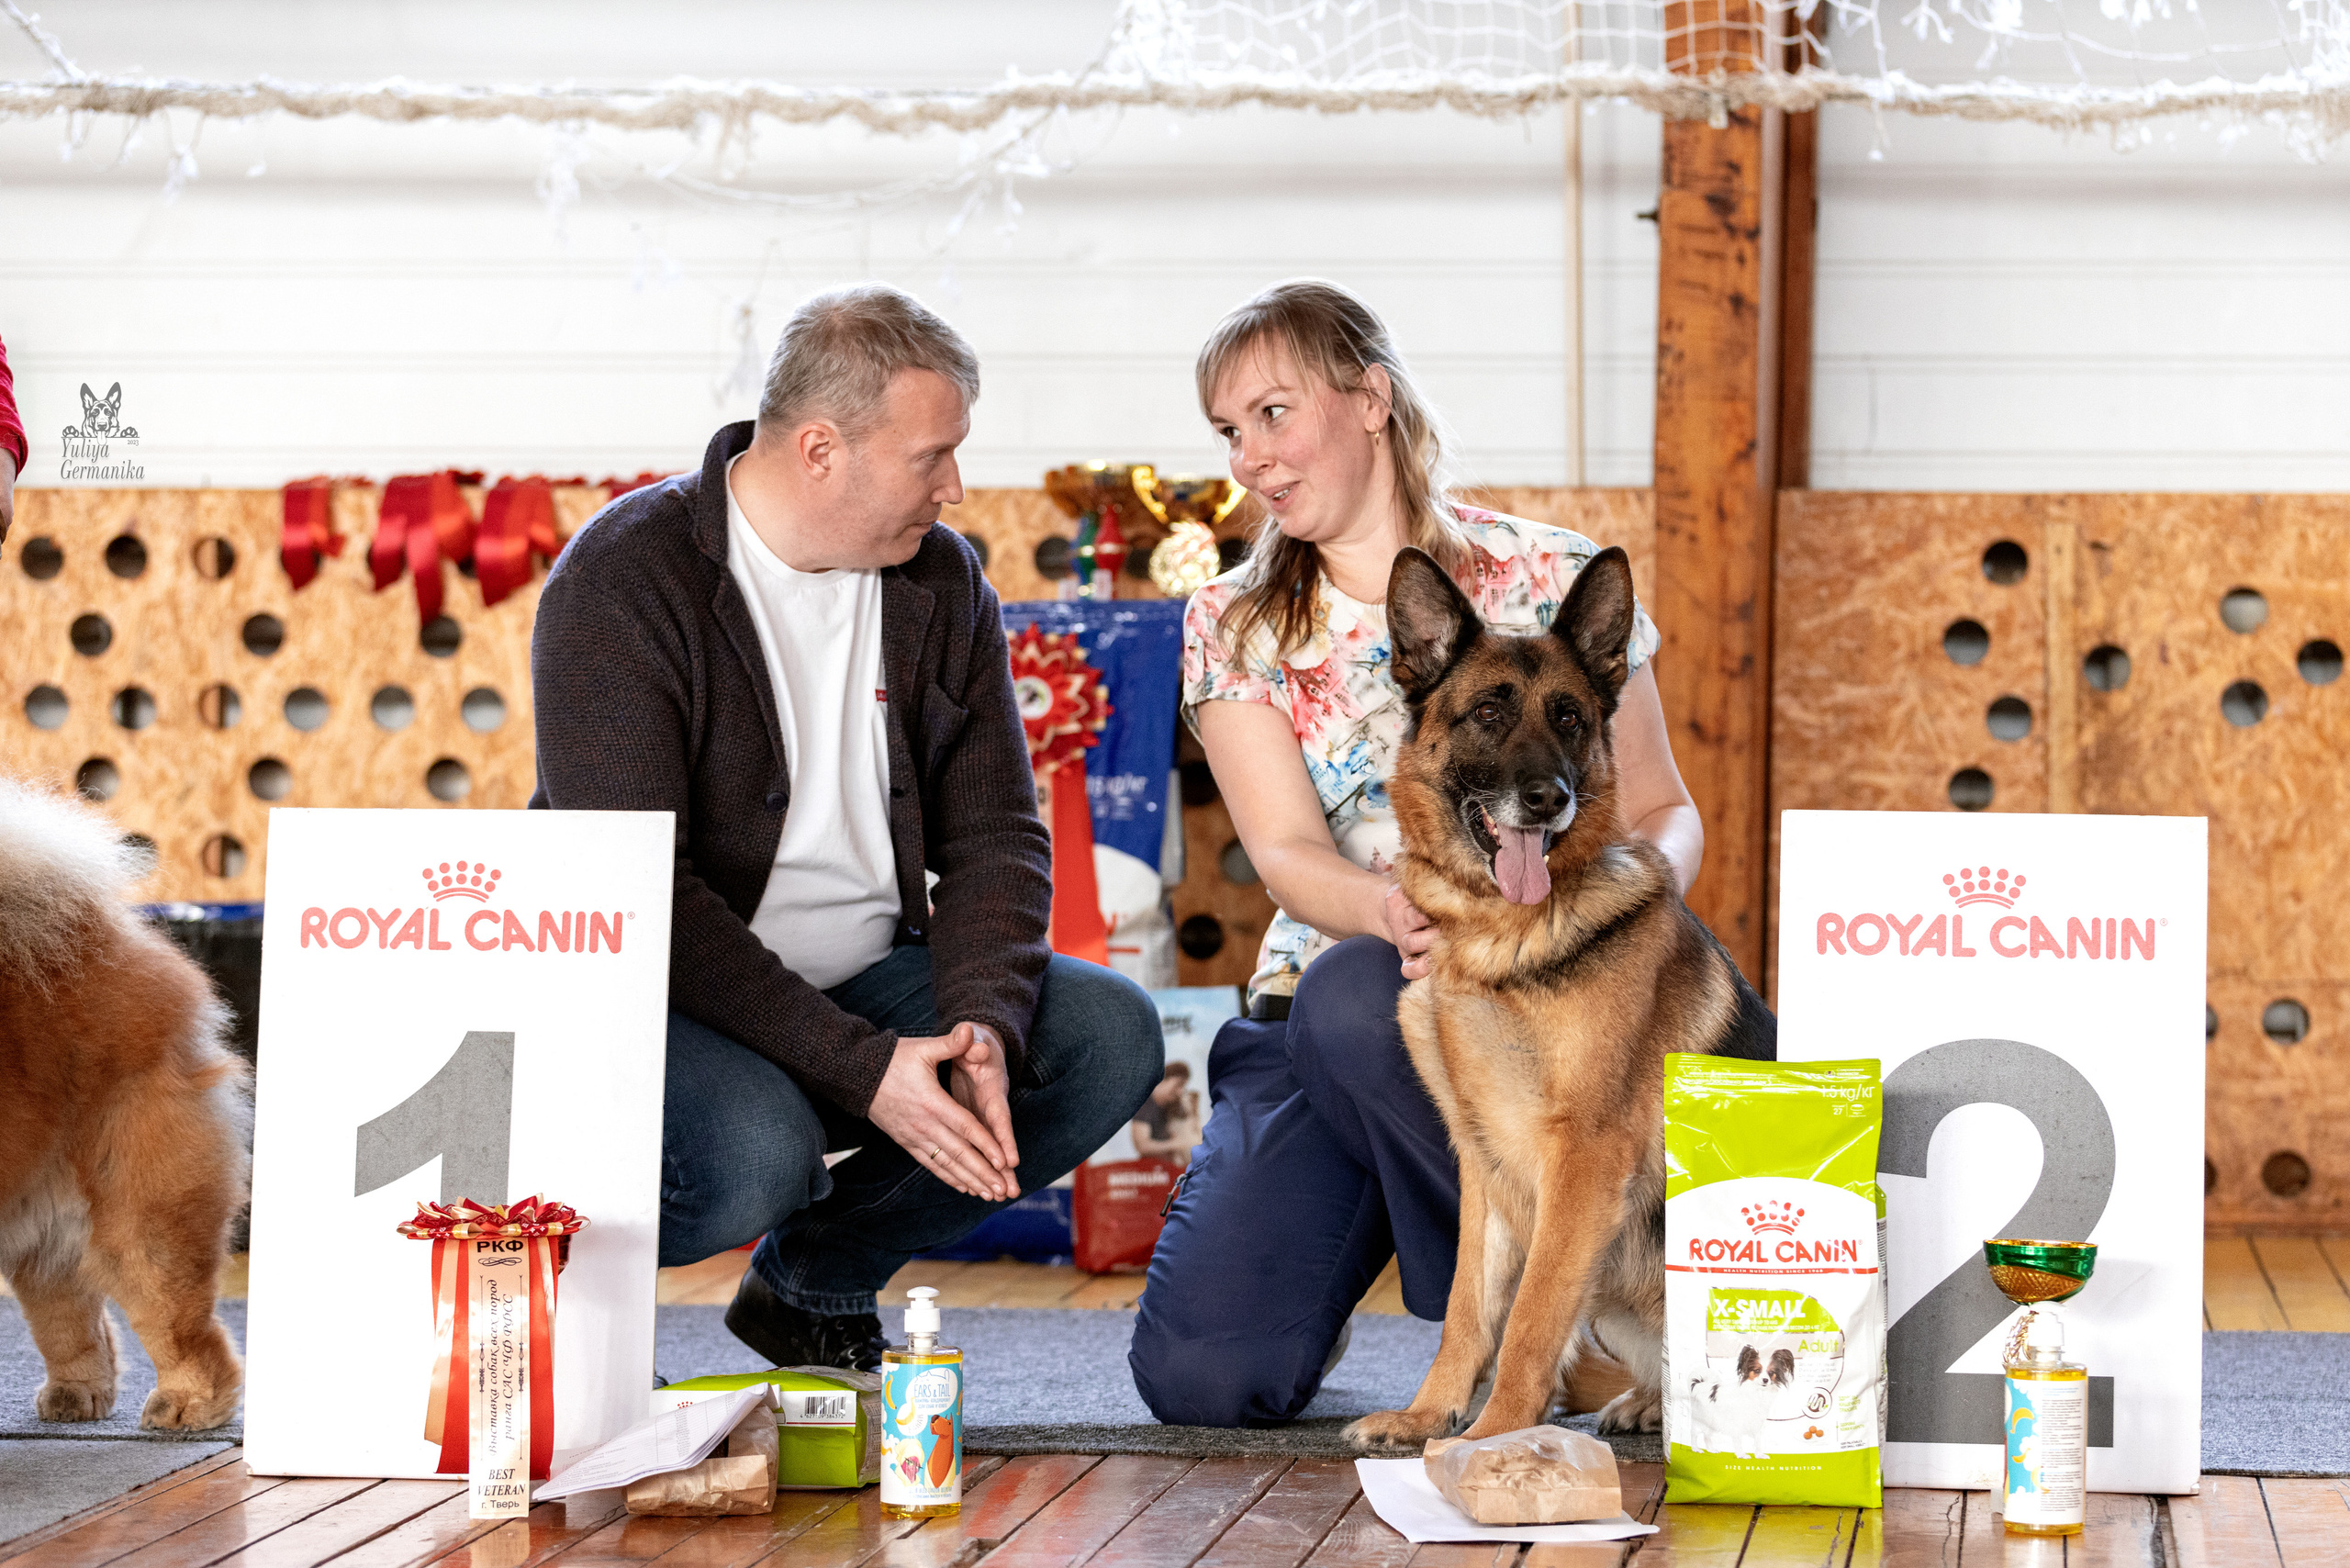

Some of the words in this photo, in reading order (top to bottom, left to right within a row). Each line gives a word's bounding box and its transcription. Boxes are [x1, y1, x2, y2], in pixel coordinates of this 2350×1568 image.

[300, 906, 452, 950] ROYAL
[464, 909, 624, 954] CANIN
[1817, 913, 1977, 958] ROYAL
[1989, 915, 2155, 961] CANIN
[354, 1031, 515, 1203] 1
[476, 1239, 524, 1253] РКФ
[1689, 1238, 1769, 1262] ROYAL
[1877, 1038, 2116, 1448] 2
[487, 1279, 500, 1315] пород
[1712, 1298, 1807, 1319] X-SMALL
[490, 1319, 499, 1346] всех
[1797, 1338, 1839, 1353] Adult
[487, 1346, 500, 1384] собак
[914, 1383, 931, 1397] EARS
[937, 1383, 951, 1397] TAIL
[505, 1403, 514, 1440] ранга
[488, 1468, 516, 1480] BEST
[477, 1484, 526, 1496] VETERAN
[490, 1499, 520, 1510] Тверь
